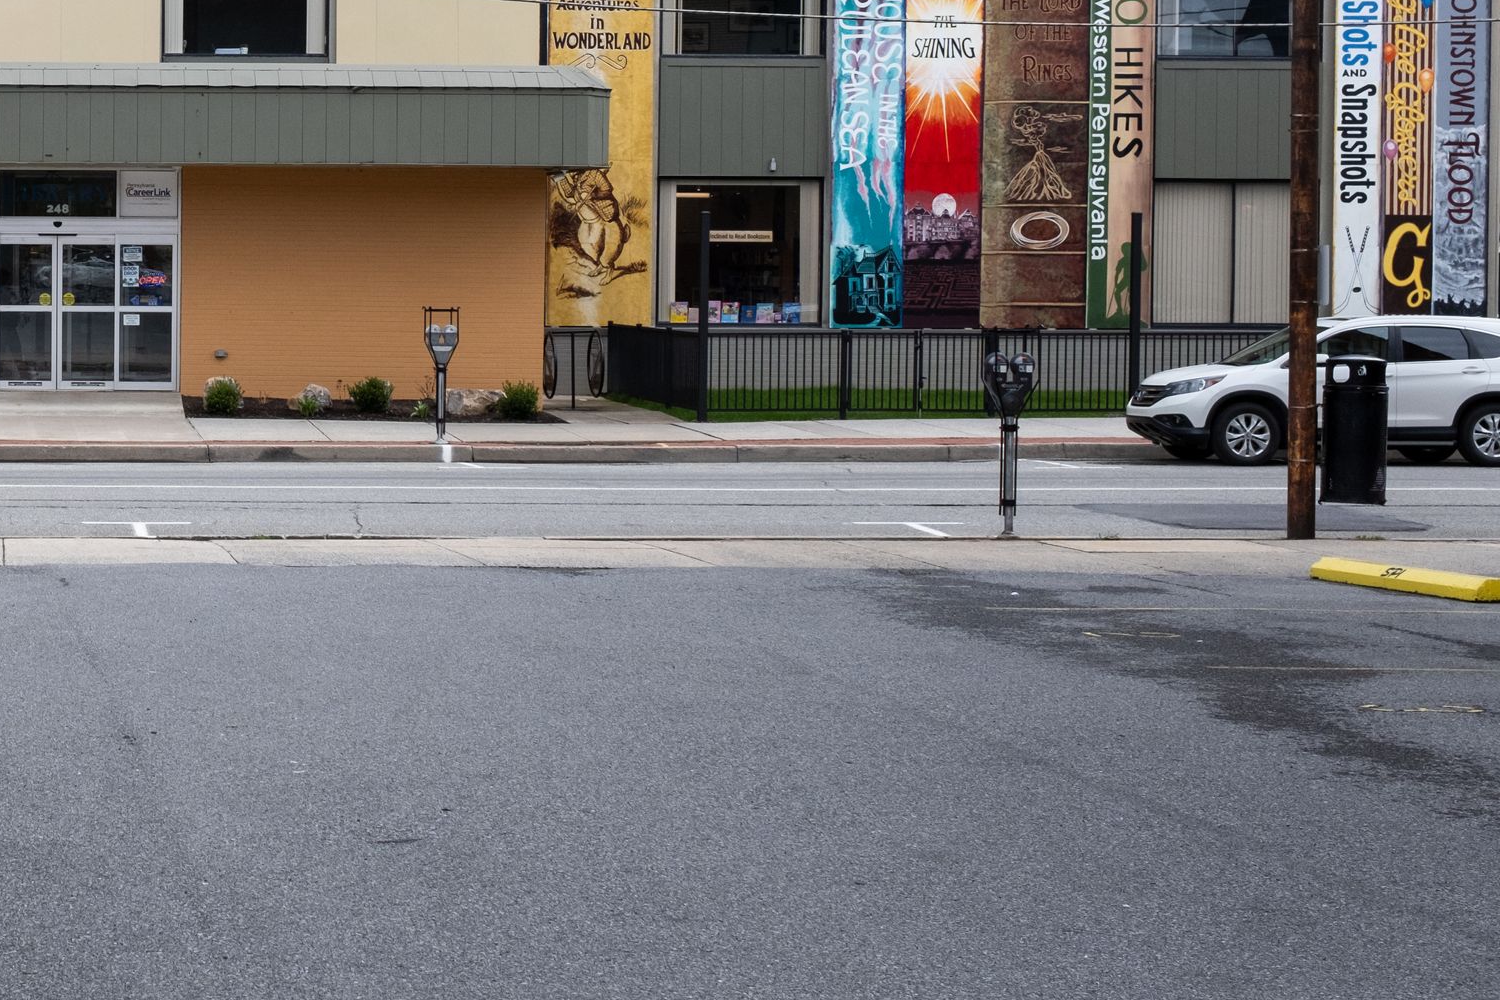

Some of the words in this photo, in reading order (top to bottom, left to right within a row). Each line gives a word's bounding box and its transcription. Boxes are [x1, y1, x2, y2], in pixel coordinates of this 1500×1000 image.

[590, 14, 604, 30] in
[934, 15, 957, 29] THE
[553, 31, 652, 51] WONDERLAND
[913, 37, 976, 59] SHINING
[1394, 15, 1428, 74] Live
[1342, 69, 1367, 78] AND
[879, 93, 898, 112] IN
[1112, 47, 1144, 159] HIKES
[840, 110, 869, 171] SEA
[877, 113, 898, 149] THE
[1336, 83, 1378, 206] Snapshots
[127, 187, 171, 197] CareerLink
[1087, 102, 1111, 261] Pennsylvania
[46, 203, 70, 214] 248
[1383, 221, 1432, 308] G
